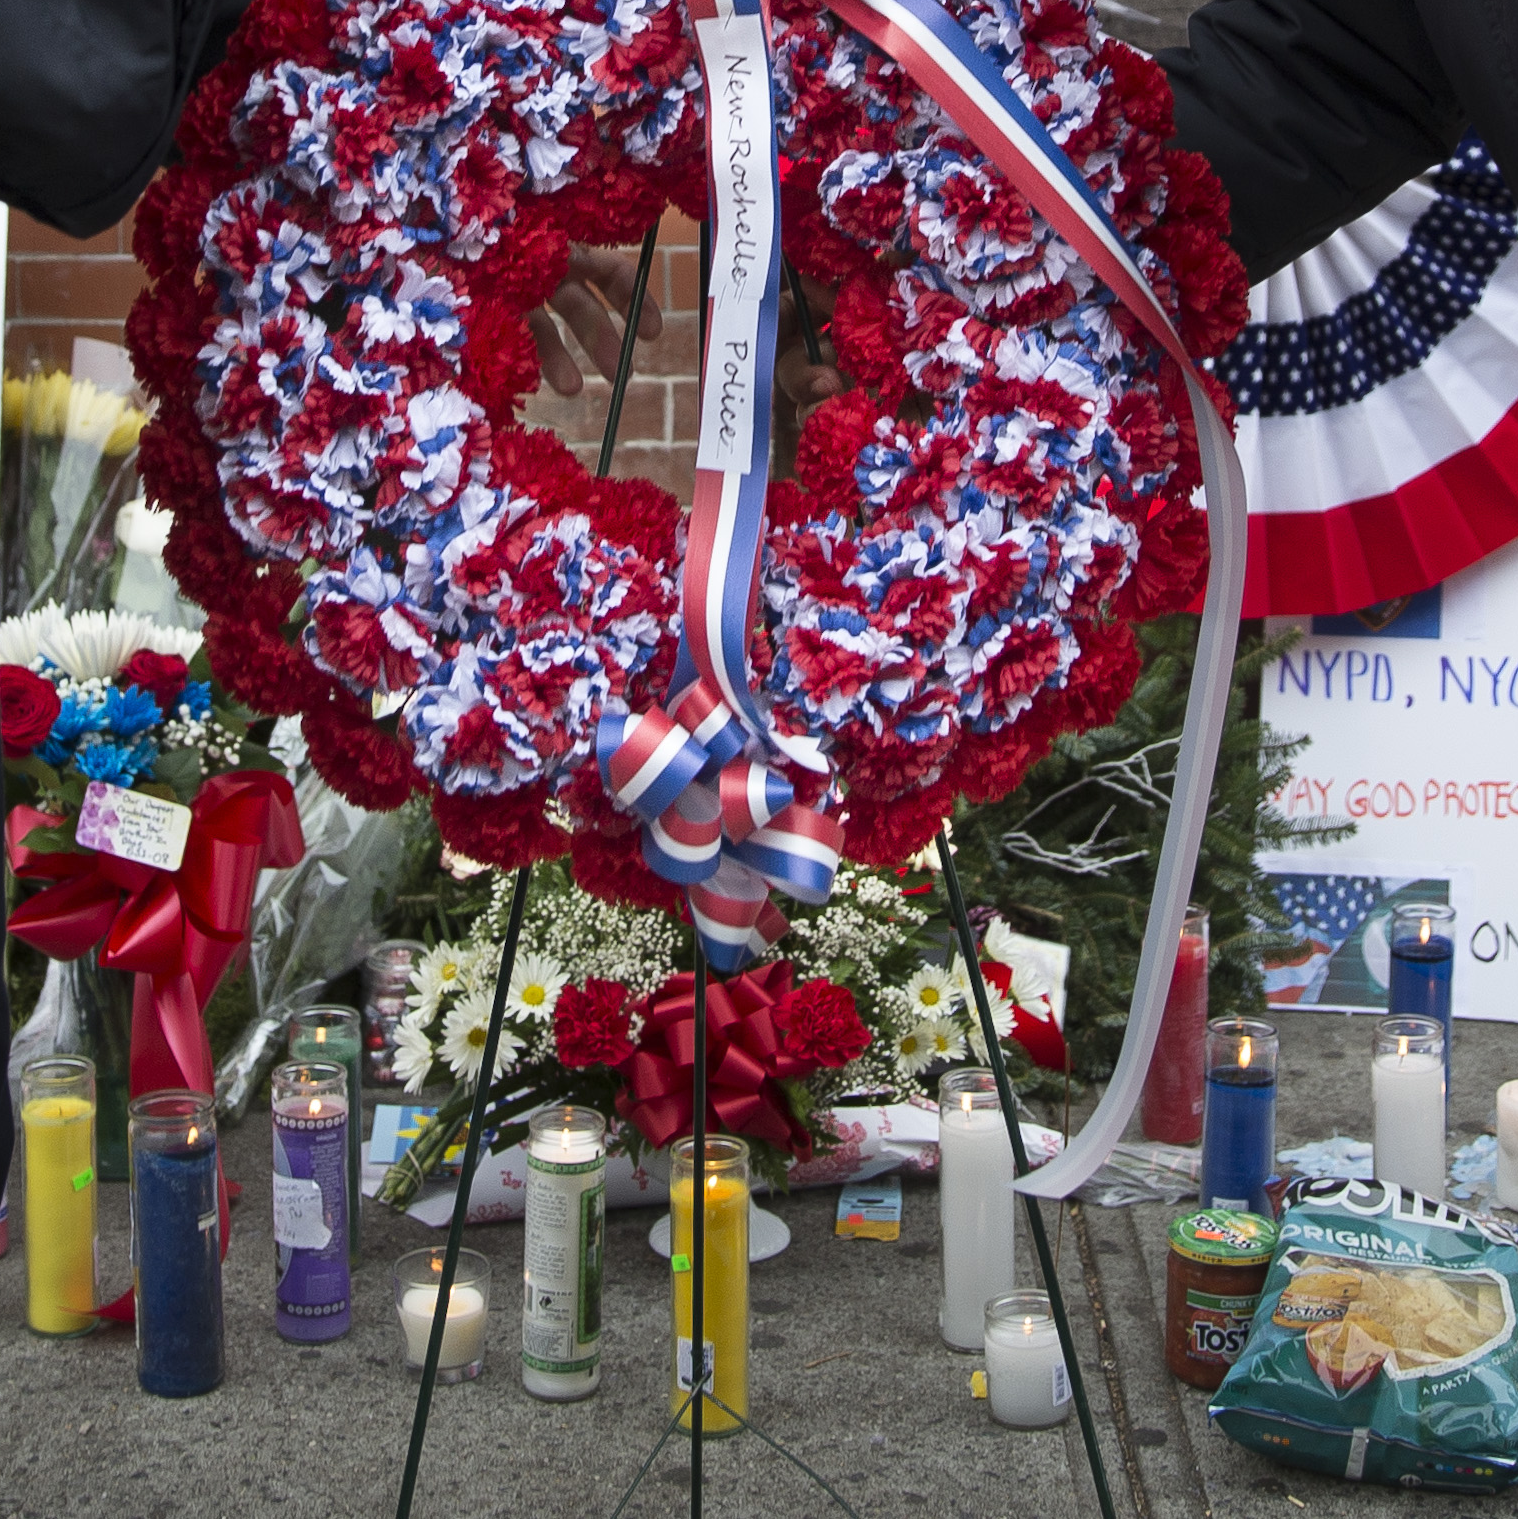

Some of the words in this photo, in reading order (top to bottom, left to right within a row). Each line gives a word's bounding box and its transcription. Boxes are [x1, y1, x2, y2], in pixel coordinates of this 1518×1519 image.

[722, 52, 753, 139] New
[727, 138, 756, 288] Rochelle
[715, 339, 749, 456] Police
[1278, 648, 1415, 710] NYPD,
[1345, 779, 1416, 820] GOD
[1279, 1222, 1434, 1261] ORIGINAL
[1219, 1298, 1254, 1310] CHUNKY
[1422, 1386, 1430, 1396] A
[1431, 1370, 1471, 1396] PARTY
